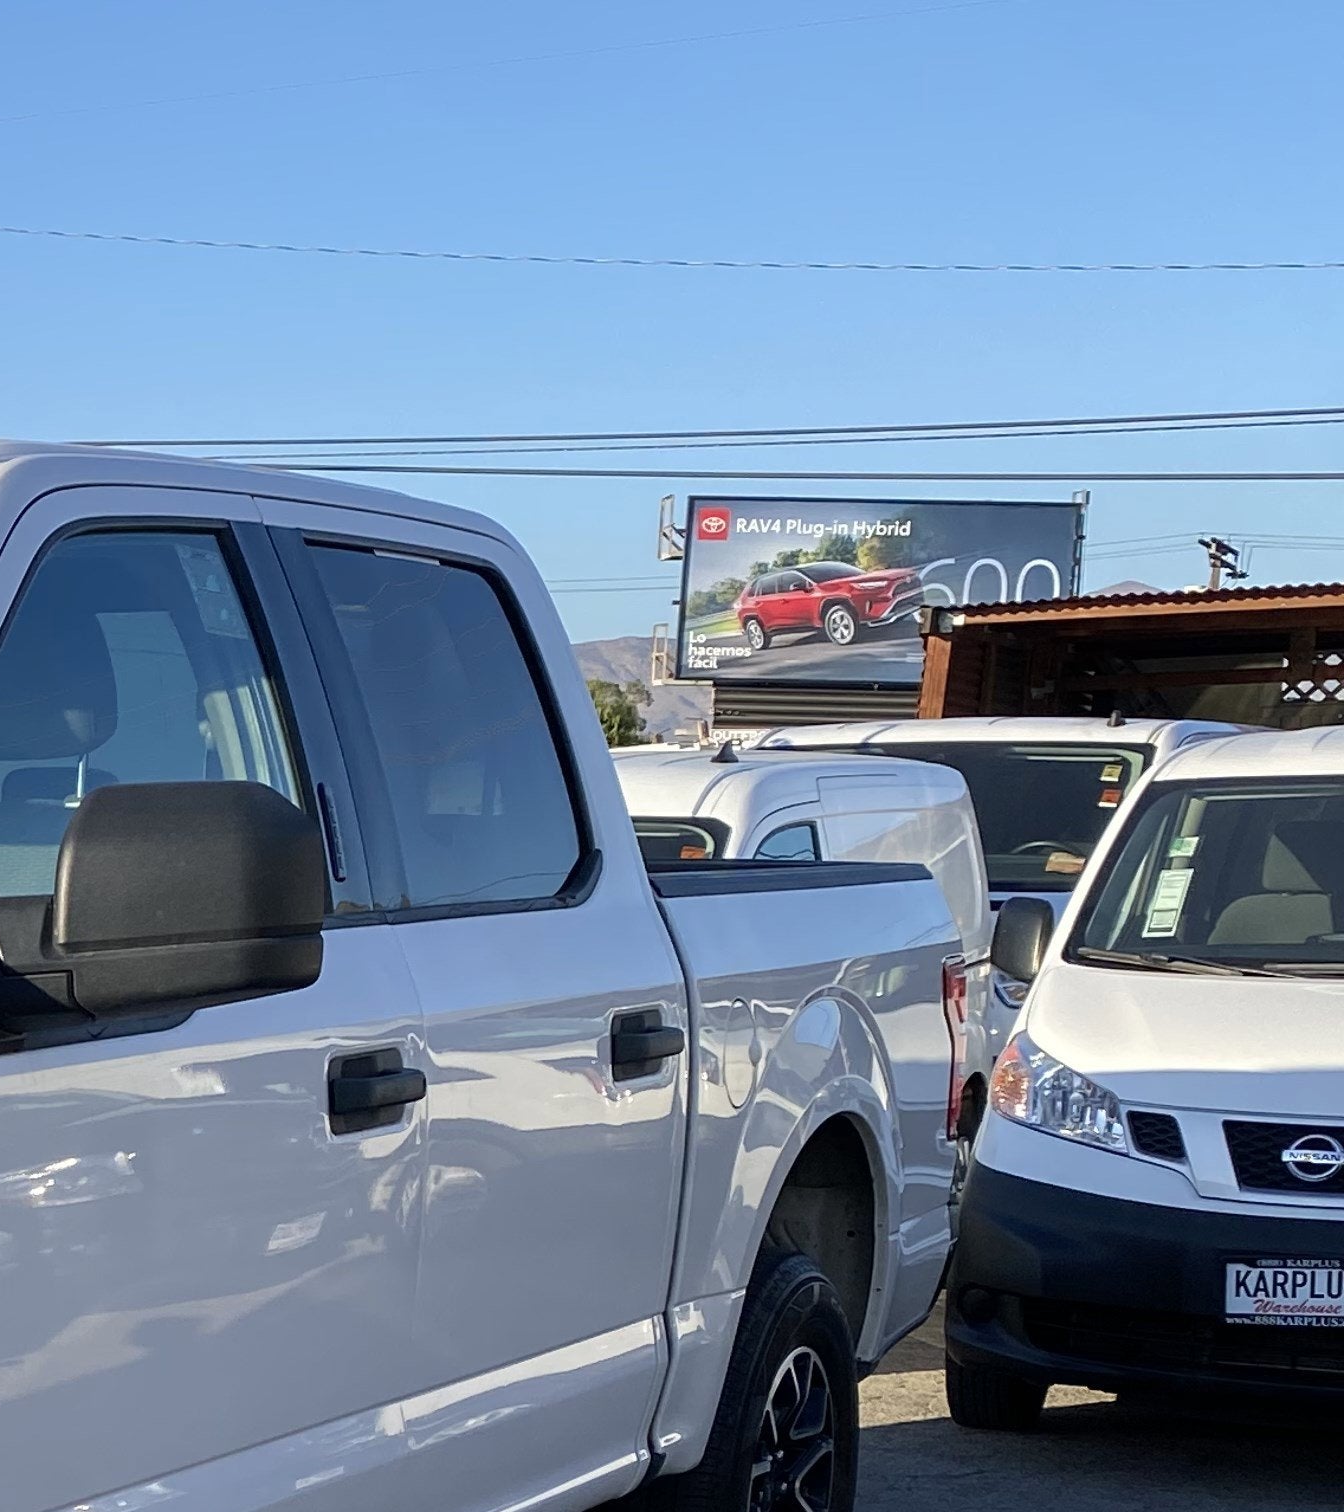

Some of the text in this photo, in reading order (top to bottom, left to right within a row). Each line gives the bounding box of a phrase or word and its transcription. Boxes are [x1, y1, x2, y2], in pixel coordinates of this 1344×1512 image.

[736, 518, 912, 539] RAV4 Plug-in Hybrid
[690, 630, 707, 644] Lo
[688, 642, 752, 657] hacemos
[1289, 1151, 1341, 1162] NISSAN
[1253, 1299, 1342, 1314] Warehouse
